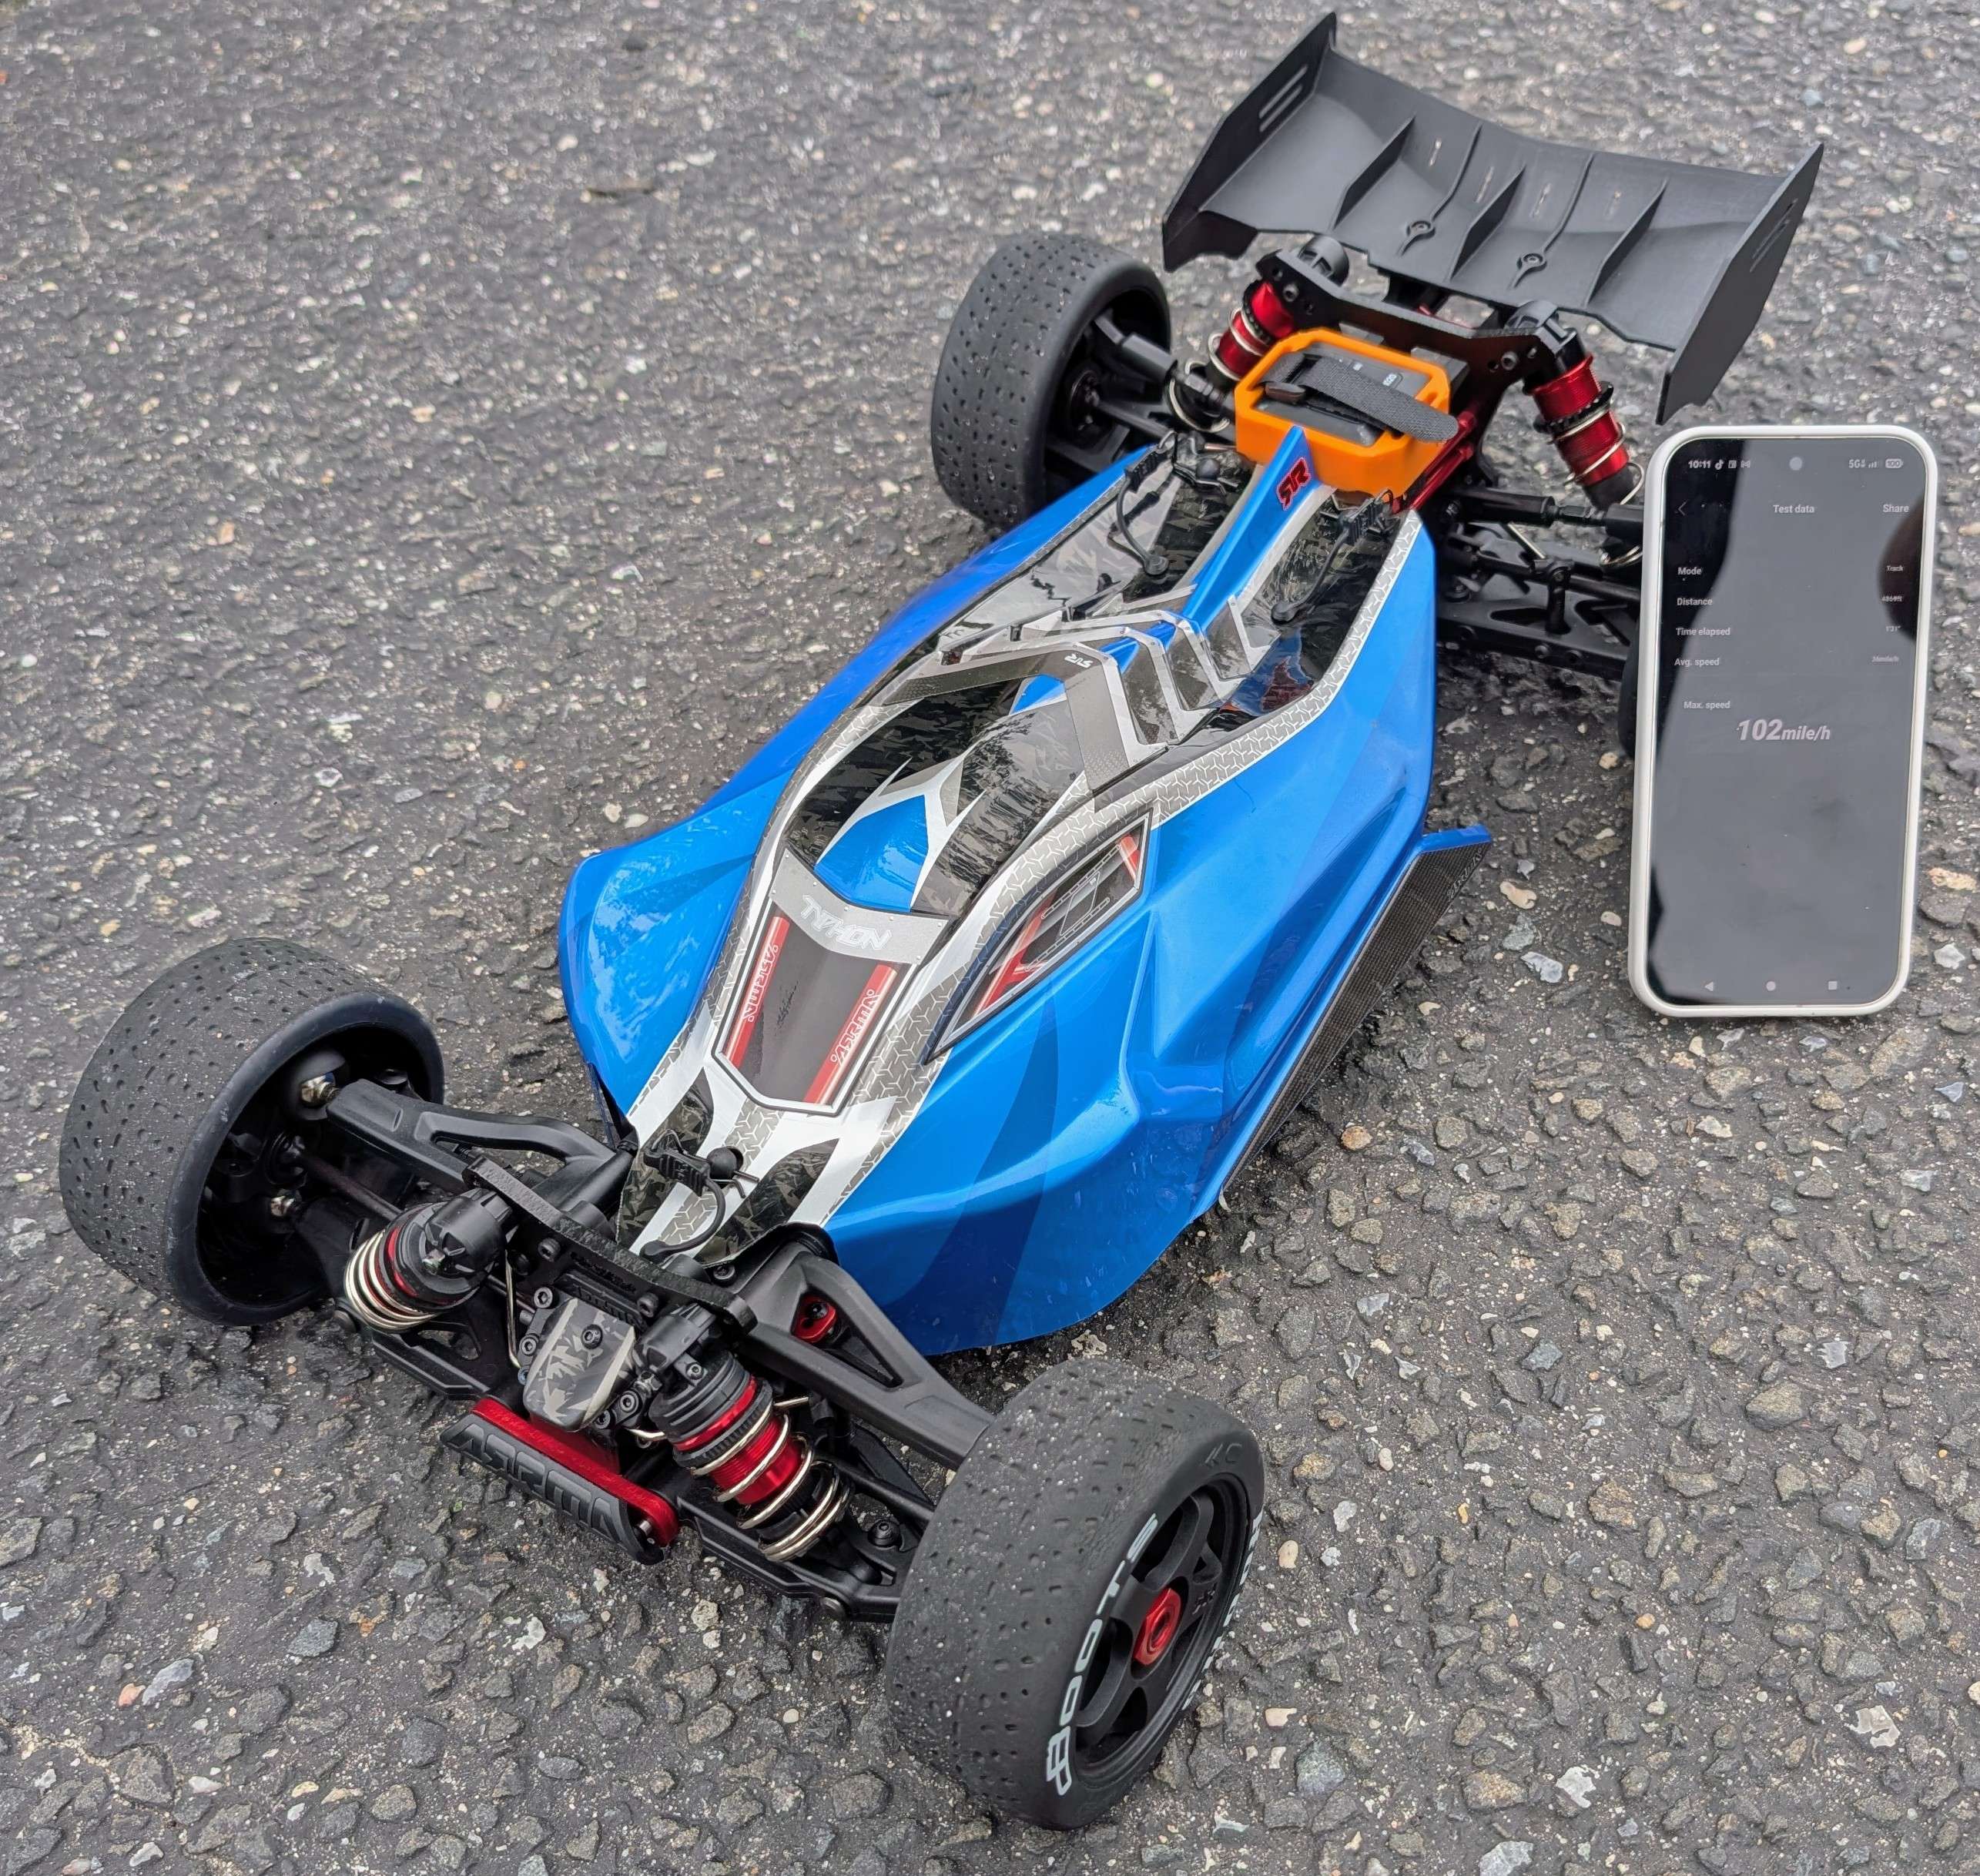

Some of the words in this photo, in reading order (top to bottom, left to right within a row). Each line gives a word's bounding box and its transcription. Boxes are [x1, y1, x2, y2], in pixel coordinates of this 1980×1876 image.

[1688, 460, 1710, 469] 10:11
[1773, 504, 1793, 514] Test
[1794, 504, 1815, 514] data
[1883, 504, 1910, 513] Share
[1677, 566, 1703, 576] Mode
[1676, 597, 1714, 606] Distance
[1675, 627, 1697, 636] Time
[1698, 627, 1731, 638] elapsed
[1674, 658, 1693, 668] Avg.
[1694, 658, 1720, 668] speed
[1684, 701, 1704, 710] Max.
[1705, 701, 1731, 711] speed
[800, 894, 892, 950] TYPHON
